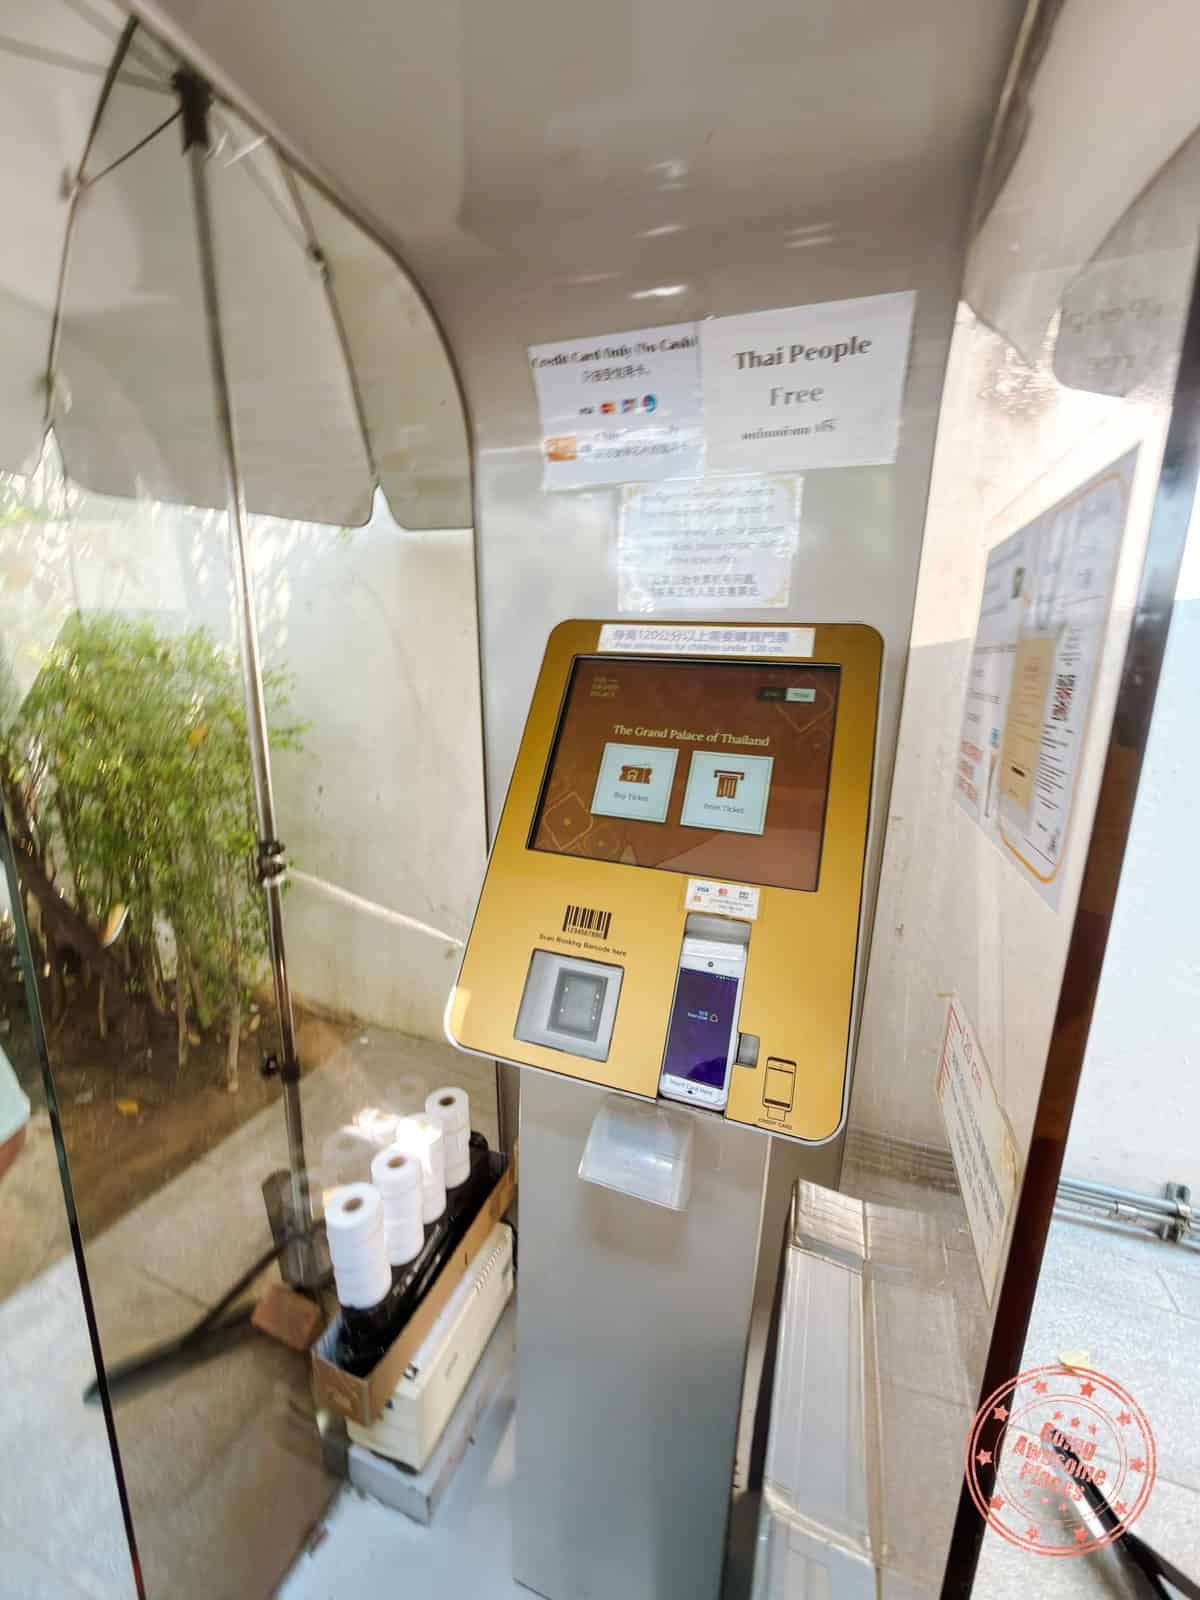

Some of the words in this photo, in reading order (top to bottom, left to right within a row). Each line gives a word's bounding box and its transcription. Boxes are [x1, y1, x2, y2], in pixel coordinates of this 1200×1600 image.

[736, 346, 784, 369] Thai
[789, 336, 872, 363] People
[769, 387, 824, 406] Free
[613, 725, 632, 736] The
[634, 727, 668, 739] Grand
[670, 729, 704, 742] Palace
[706, 731, 720, 742] of
[720, 733, 770, 746] Thailand
